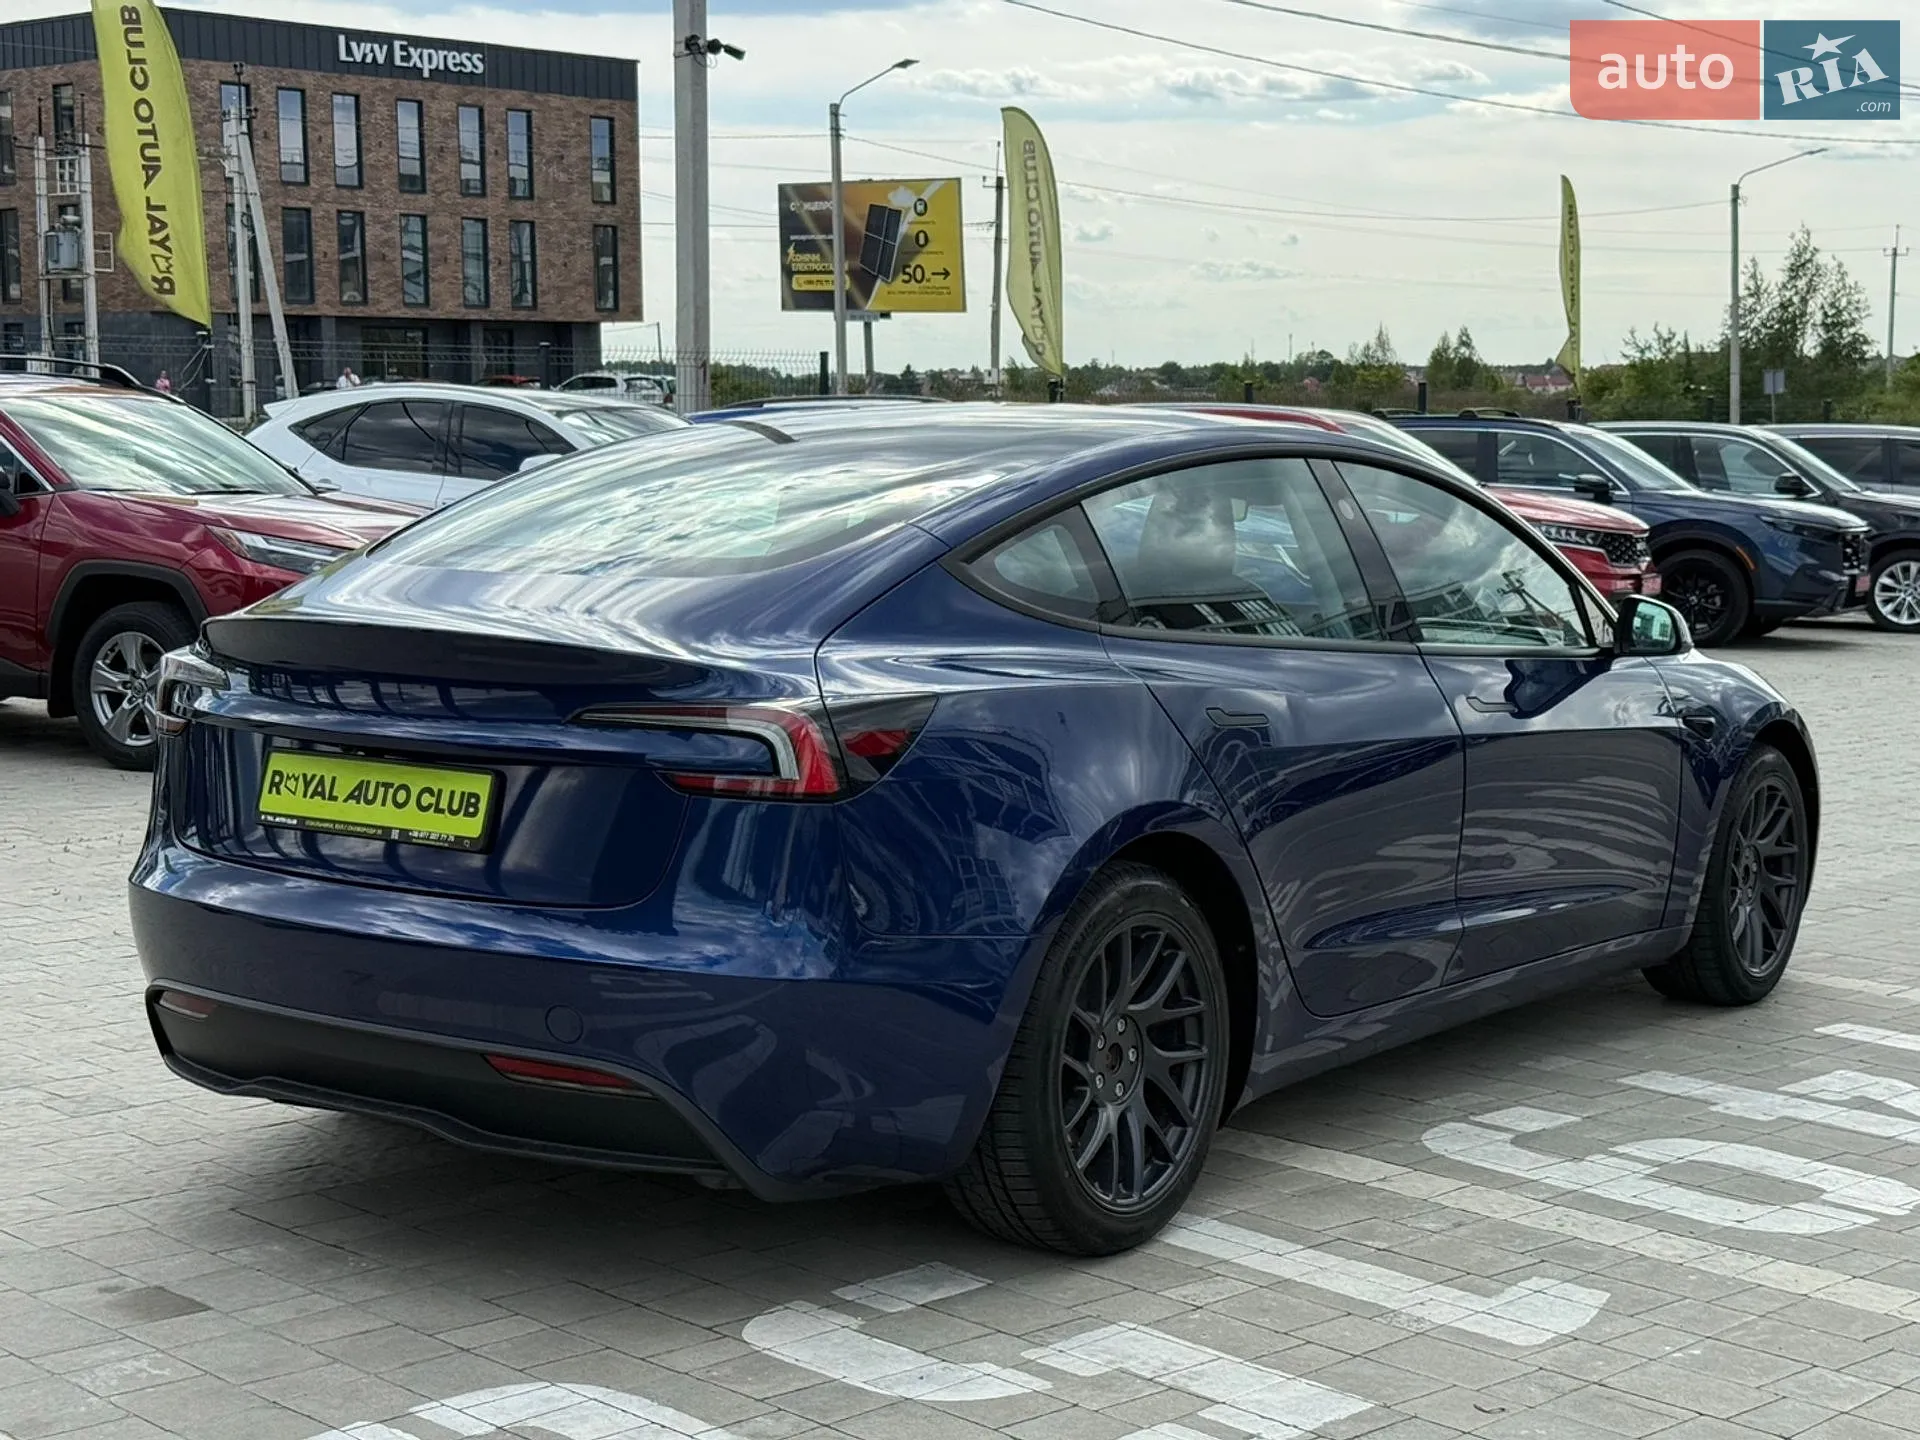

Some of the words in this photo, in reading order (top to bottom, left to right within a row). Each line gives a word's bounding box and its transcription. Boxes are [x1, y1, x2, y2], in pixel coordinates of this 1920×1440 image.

[337, 34, 389, 64] Lviv
[393, 40, 484, 78] Express
[901, 264, 925, 284] 50
[343, 779, 412, 810] AUTO
[415, 786, 482, 818] CLUB
